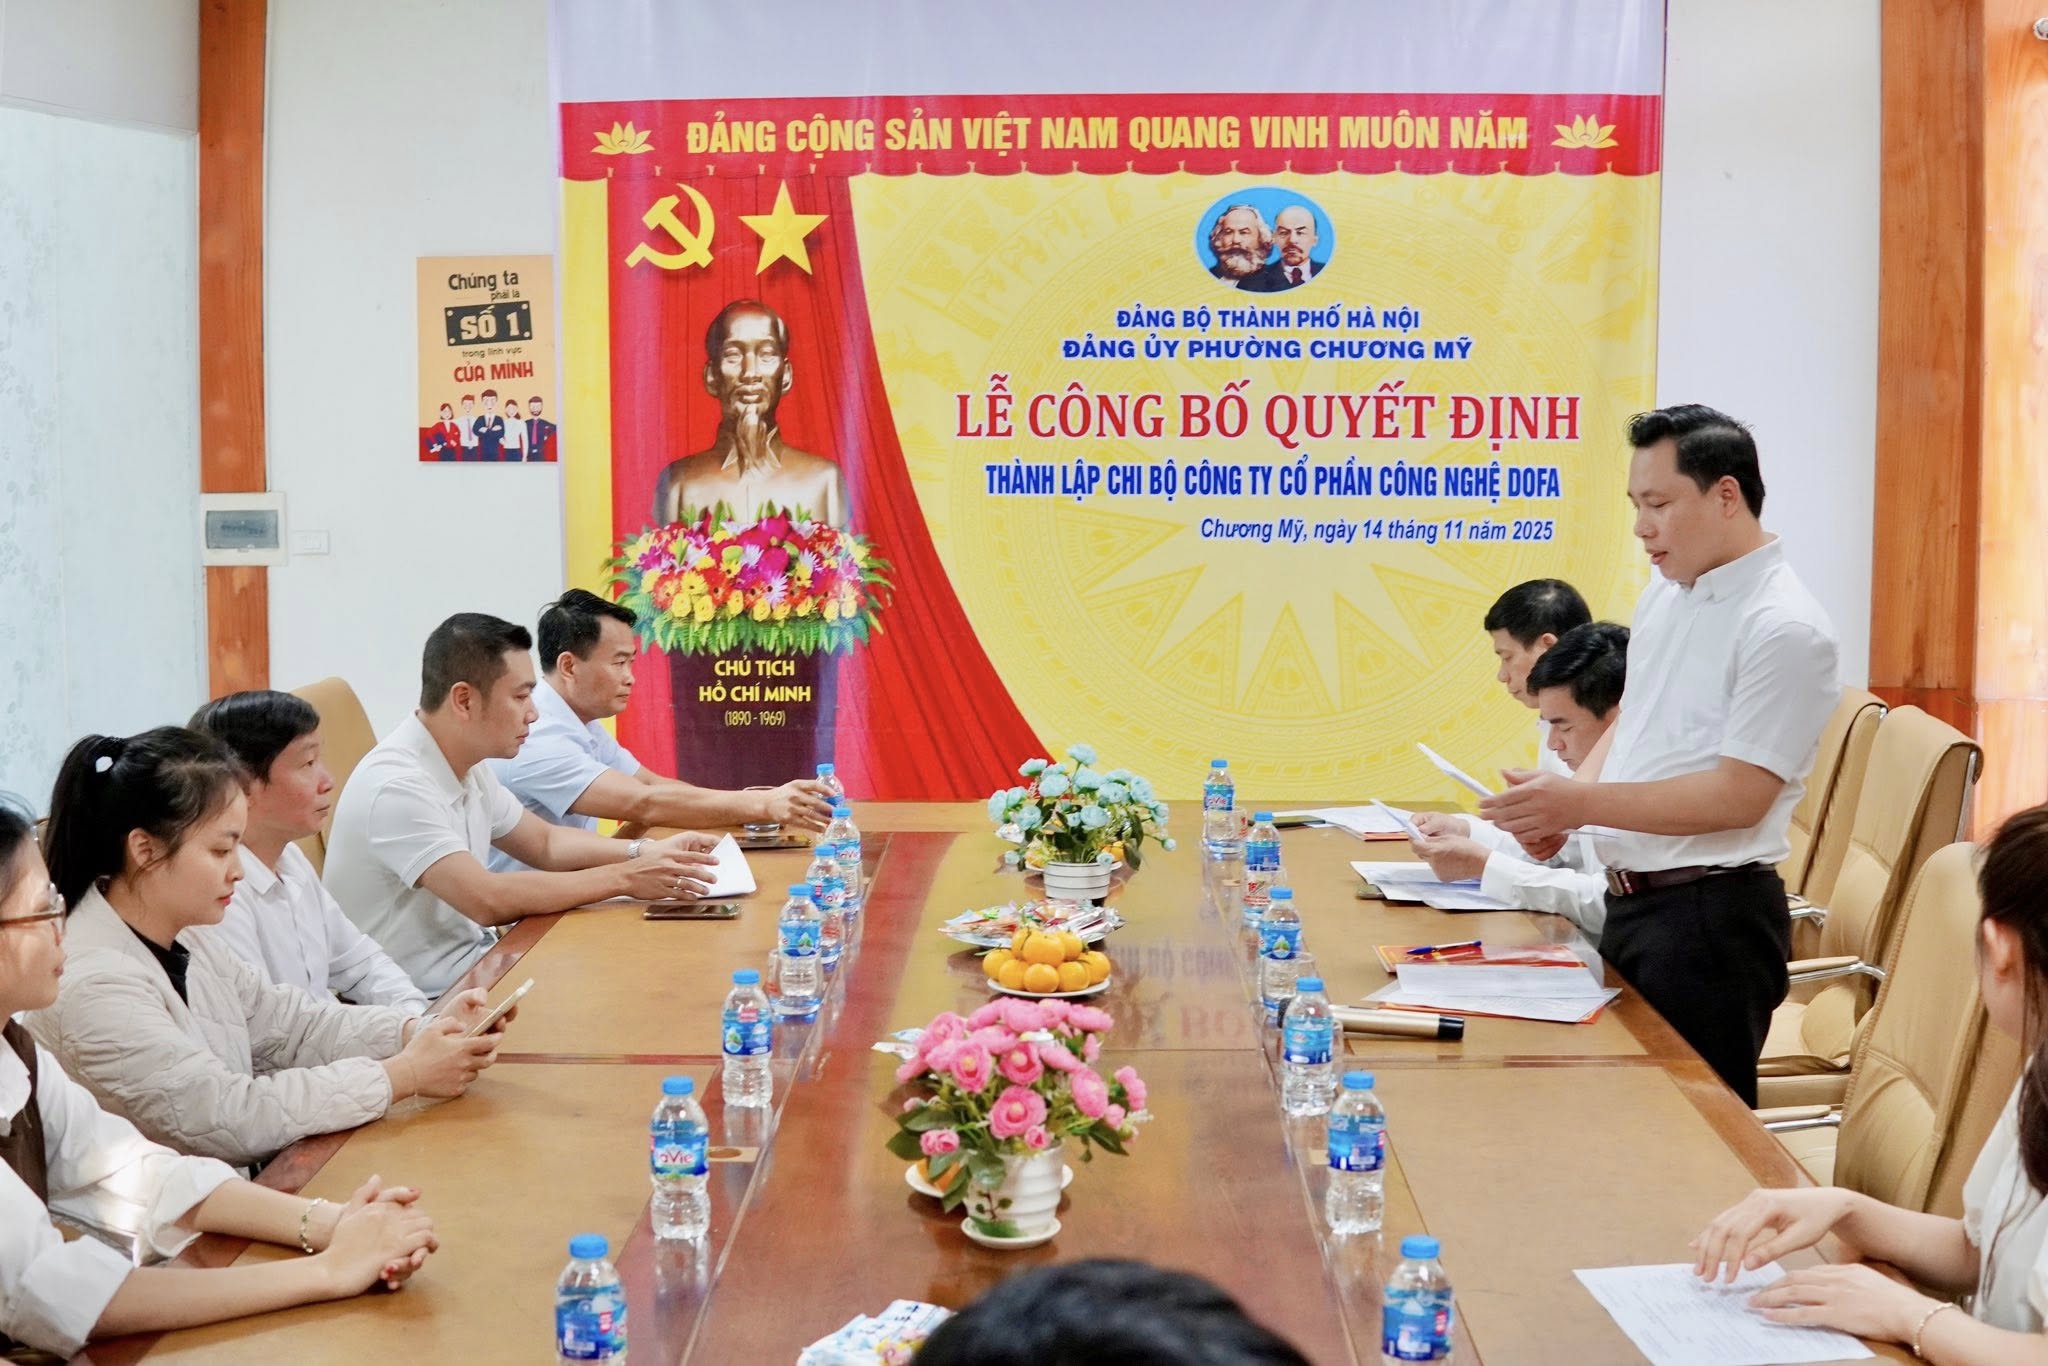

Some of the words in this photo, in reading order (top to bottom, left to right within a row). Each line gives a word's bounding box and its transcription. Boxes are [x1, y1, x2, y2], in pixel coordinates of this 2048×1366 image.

[686, 110, 776, 154] ĐẢNG
[786, 113, 875, 159] CỘNG
[885, 107, 952, 151] SẢN
[962, 110, 1032, 157] VIỆT
[1041, 116, 1118, 149] NAM
[1129, 115, 1240, 153] QUANG
[1250, 116, 1329, 148] VINH
[1339, 109, 1440, 149] MUÔN
[1450, 109, 1528, 149] NĂM
[448, 272, 497, 292] Chúng
[502, 270, 519, 286] ta
[460, 304, 497, 340] SỐ
[506, 311, 520, 337] 1
[1116, 303, 1176, 328] ĐẢNG
[1182, 305, 1212, 333] BỘ
[1217, 305, 1290, 328] THÀNH
[1297, 303, 1342, 329] PHỐ
[1347, 306, 1376, 329] HÀ
[1382, 306, 1419, 334] NỘI
[462, 349, 485, 358] trong
[1062, 332, 1136, 359] ĐẢNG
[1144, 332, 1180, 359] ỦY
[1188, 335, 1302, 359] PHƯỜNG
[1309, 340, 1425, 360] CHƯƠNG
[1434, 336, 1473, 360] MỸ
[453, 360, 485, 383] CỦA
[957, 373, 1013, 437] LỄ
[1028, 381, 1164, 438] CÔNG
[1180, 379, 1250, 438] BỐ
[1264, 380, 1436, 449] QUYẾT
[1449, 395, 1580, 452] ĐỊNH
[985, 458, 1055, 495] THÀNH
[1061, 458, 1101, 502] LẬP
[1107, 464, 1143, 496] CHI
[1149, 458, 1177, 502] BỘ
[1184, 458, 1242, 496] CÔNG
[1248, 465, 1273, 496] TY
[1279, 453, 1309, 496] CỔ
[1314, 455, 1373, 496] PHẦN
[1379, 460, 1437, 497] CÔNG
[1444, 460, 1501, 504] NGHỆ
[1507, 467, 1560, 498] DOFA
[1201, 517, 1273, 544] Chương
[1277, 518, 1308, 544] Mỹ,
[1313, 518, 1358, 544] ngày
[1363, 519, 1383, 539] 14
[1388, 519, 1438, 545] tháng
[1444, 520, 1463, 540] 11
[1468, 520, 1507, 540] năm
[1512, 520, 1553, 541] 2025
[714, 655, 752, 677] CHỦ
[754, 659, 795, 679] TỊCH
[699, 679, 727, 702] HỒ
[730, 682, 760, 702] CHÍ
[763, 685, 811, 702] MINH
[724, 710, 751, 727] (1890
[759, 710, 786, 727] 1969)
